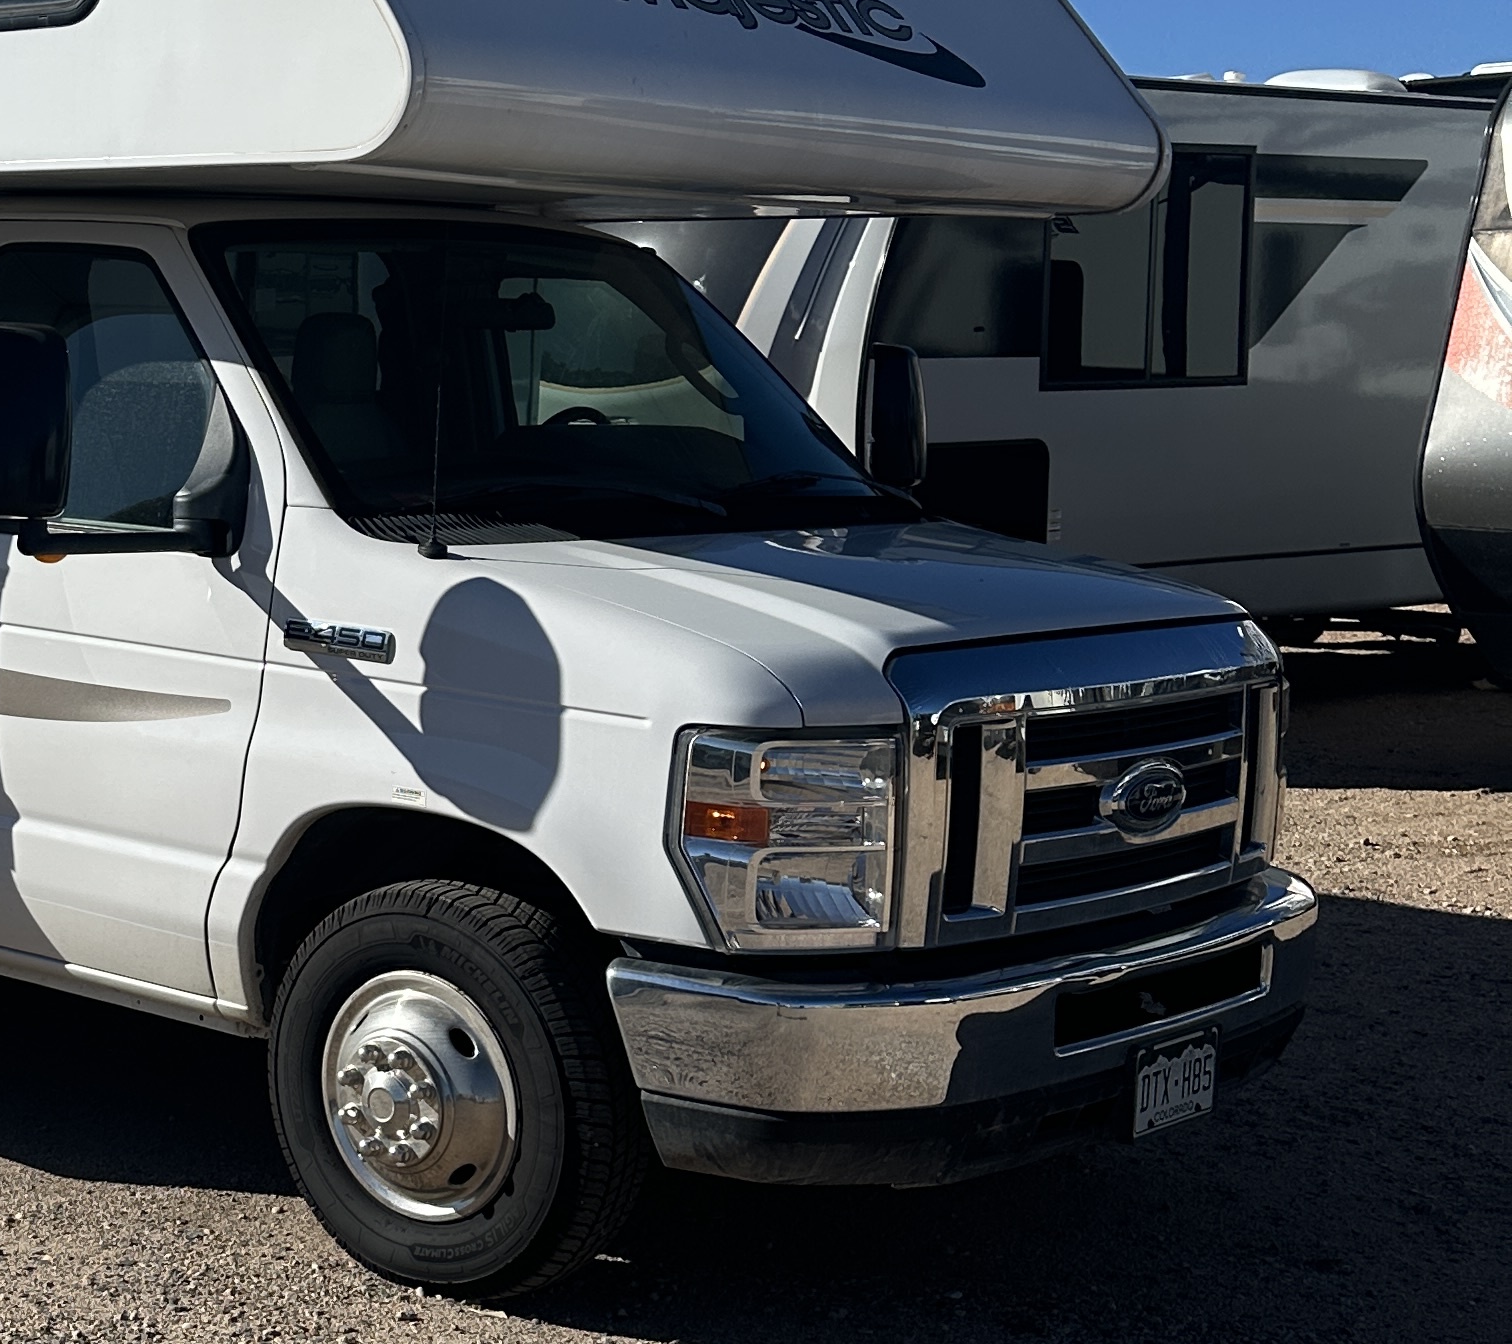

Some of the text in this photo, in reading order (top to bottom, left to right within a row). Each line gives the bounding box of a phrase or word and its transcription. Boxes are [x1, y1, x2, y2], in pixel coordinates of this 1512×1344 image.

[327, 646, 384, 661] SUPER DUTY
[1140, 781, 1176, 814] Ford
[441, 943, 520, 1026] MICHELIN
[1153, 1099, 1194, 1123] COLORADO
